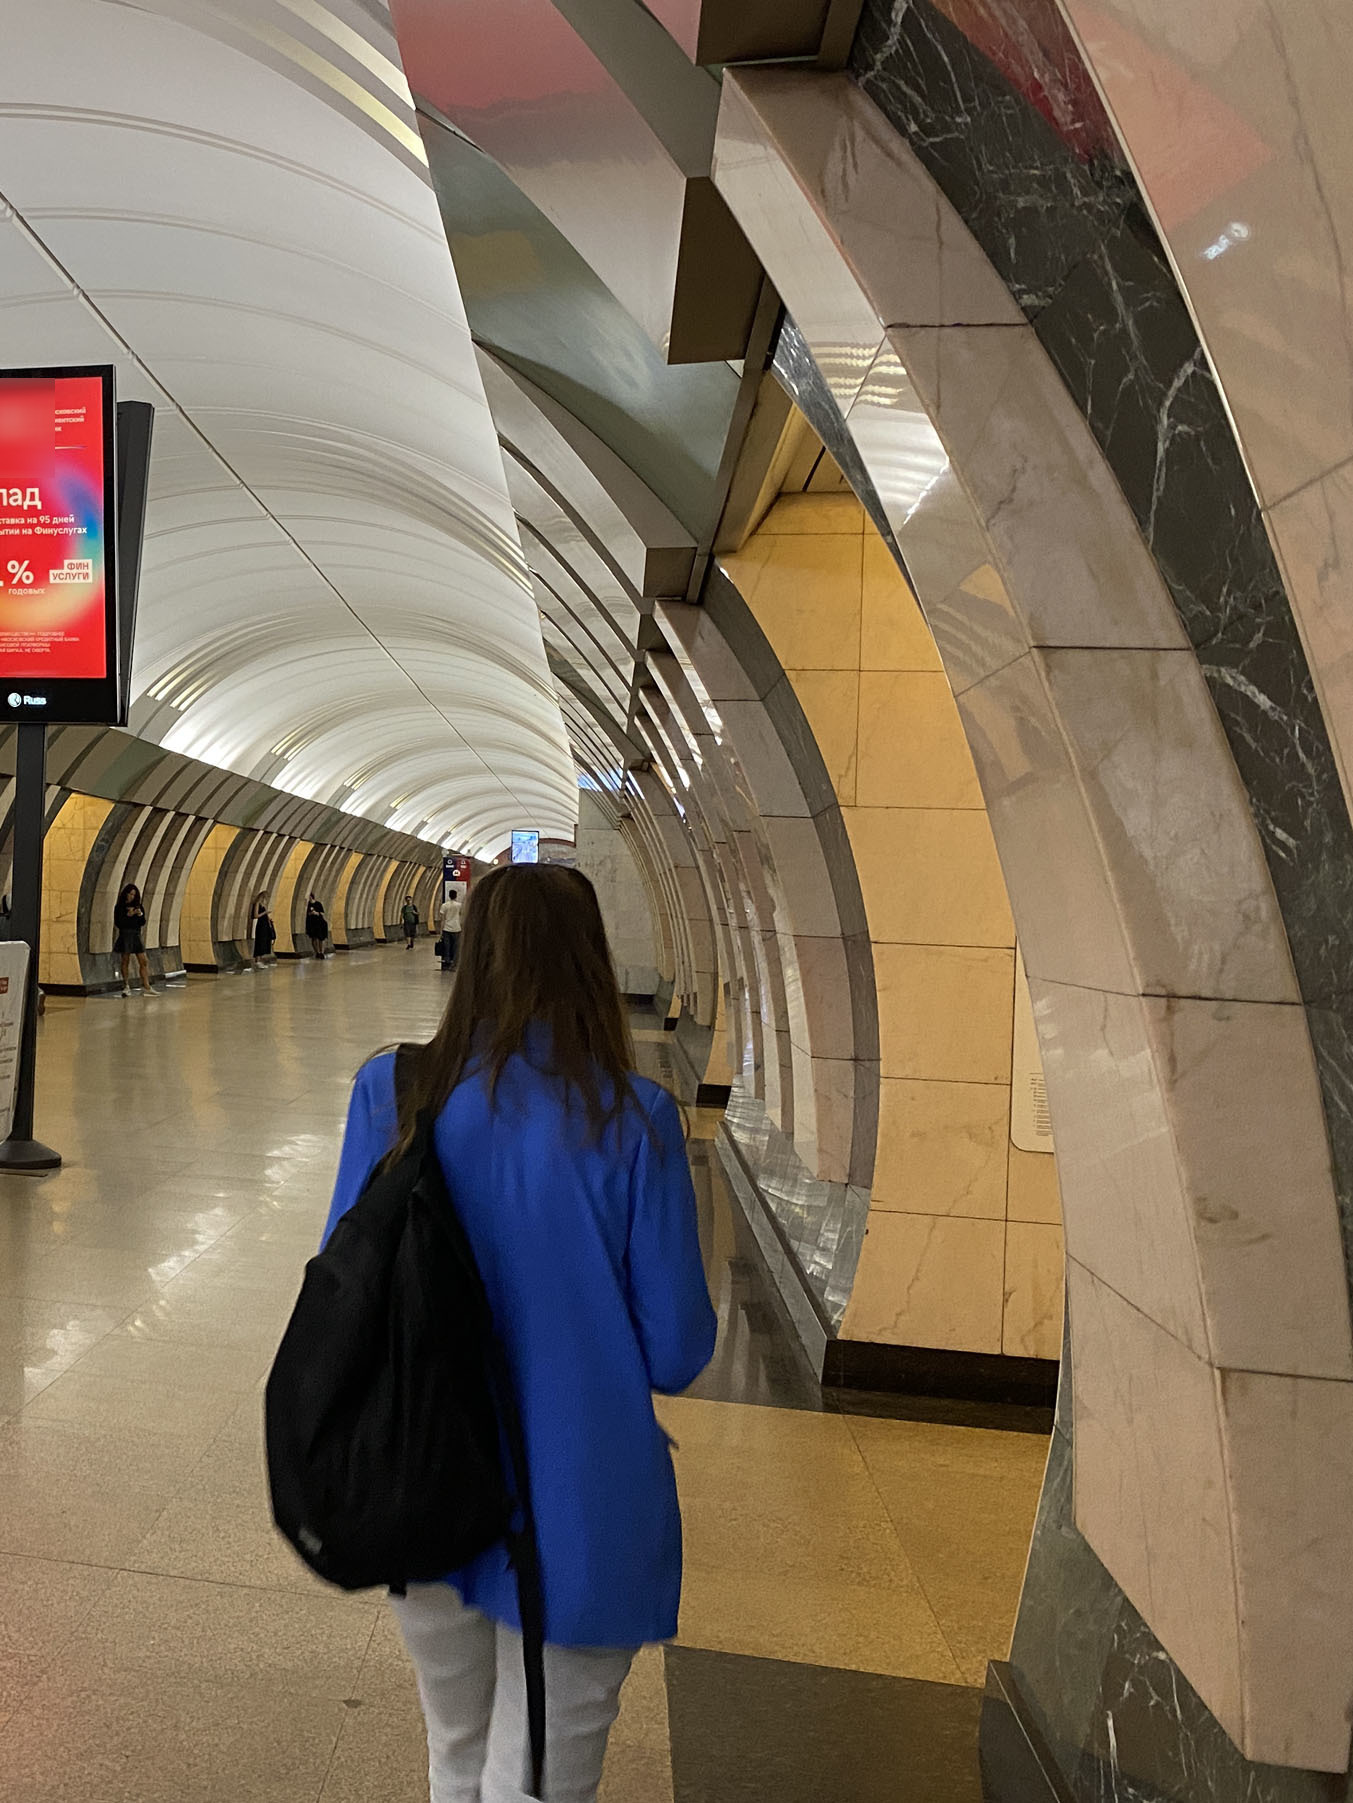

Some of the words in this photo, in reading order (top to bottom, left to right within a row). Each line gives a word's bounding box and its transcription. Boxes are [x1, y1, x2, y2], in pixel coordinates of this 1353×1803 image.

[28, 516, 37, 524] на
[39, 515, 50, 524] 95
[52, 514, 75, 525] дней
[34, 526, 87, 536] Финуслугах
[66, 562, 89, 570] ФИН
[52, 572, 89, 581] УСЛУГИ
[8, 588, 46, 596] годовых
